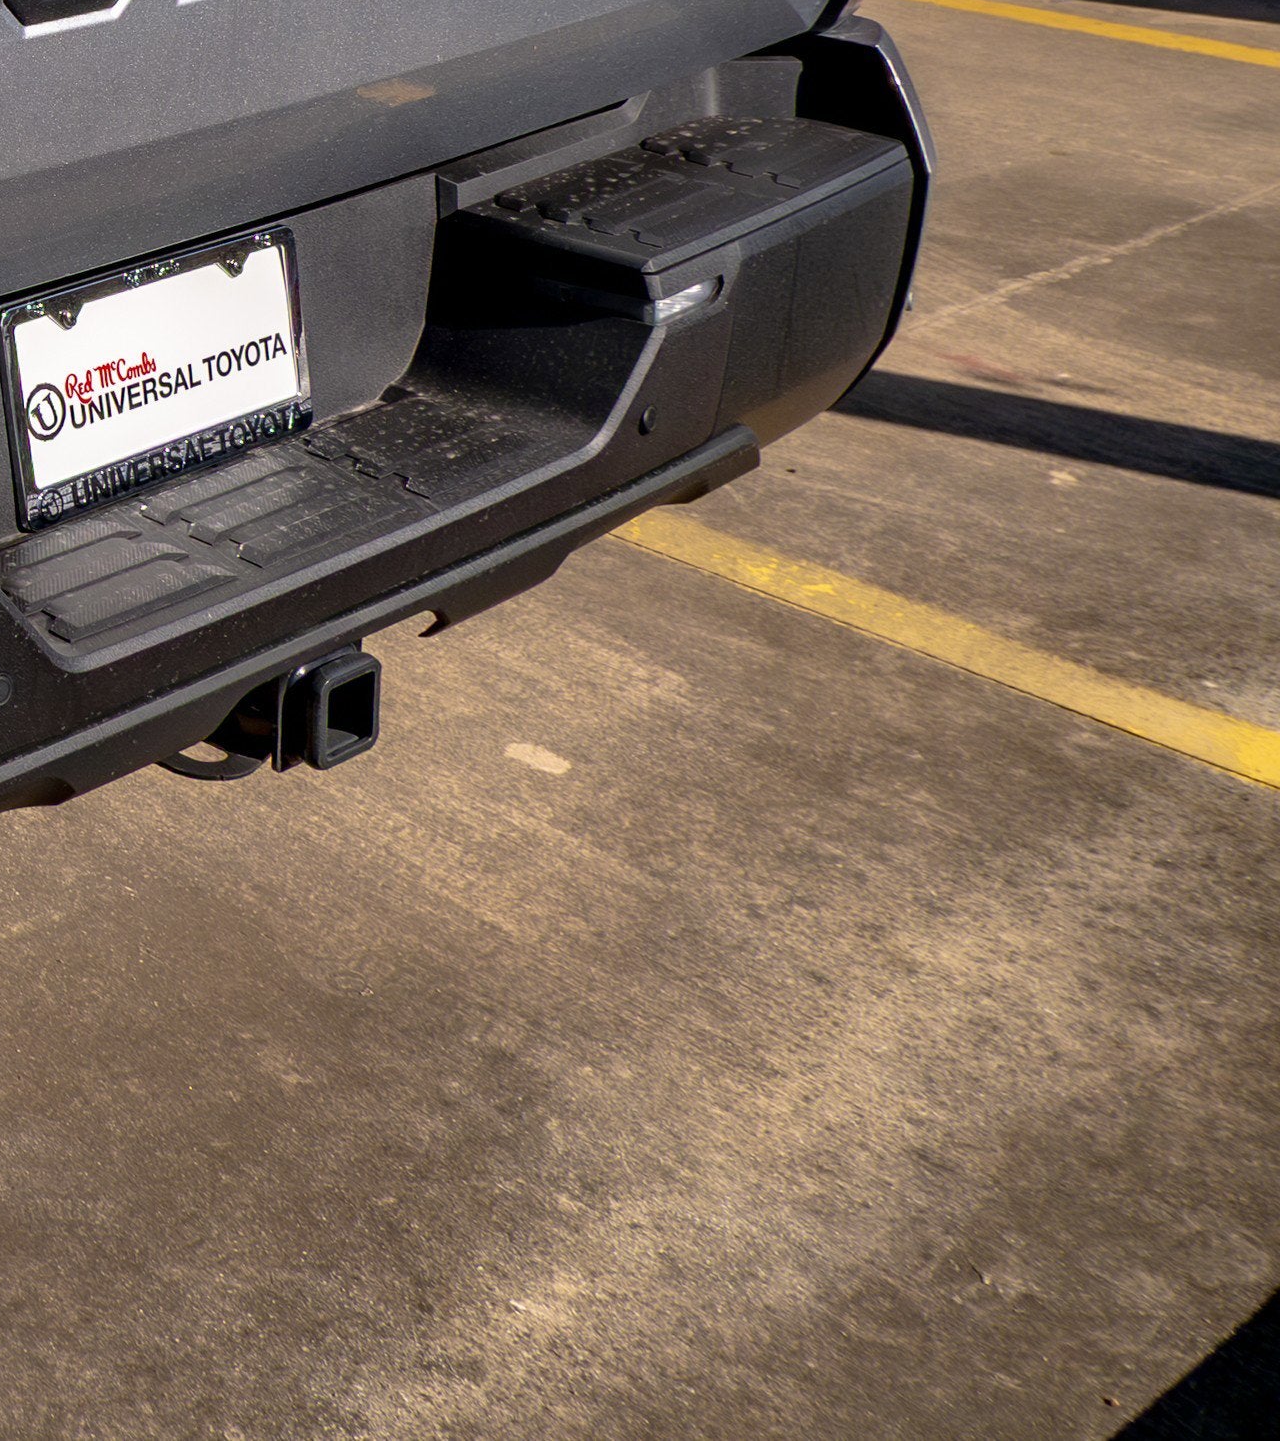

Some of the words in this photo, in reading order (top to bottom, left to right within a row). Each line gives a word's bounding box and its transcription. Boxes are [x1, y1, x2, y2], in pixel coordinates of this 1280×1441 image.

[65, 372, 93, 404] Red
[94, 352, 157, 389] McCombs
[69, 371, 202, 429] UNIVERSAL
[203, 333, 288, 382] TOYOTA
[71, 435, 213, 507] UNIVERSAL
[211, 401, 306, 455] TOYOTA
